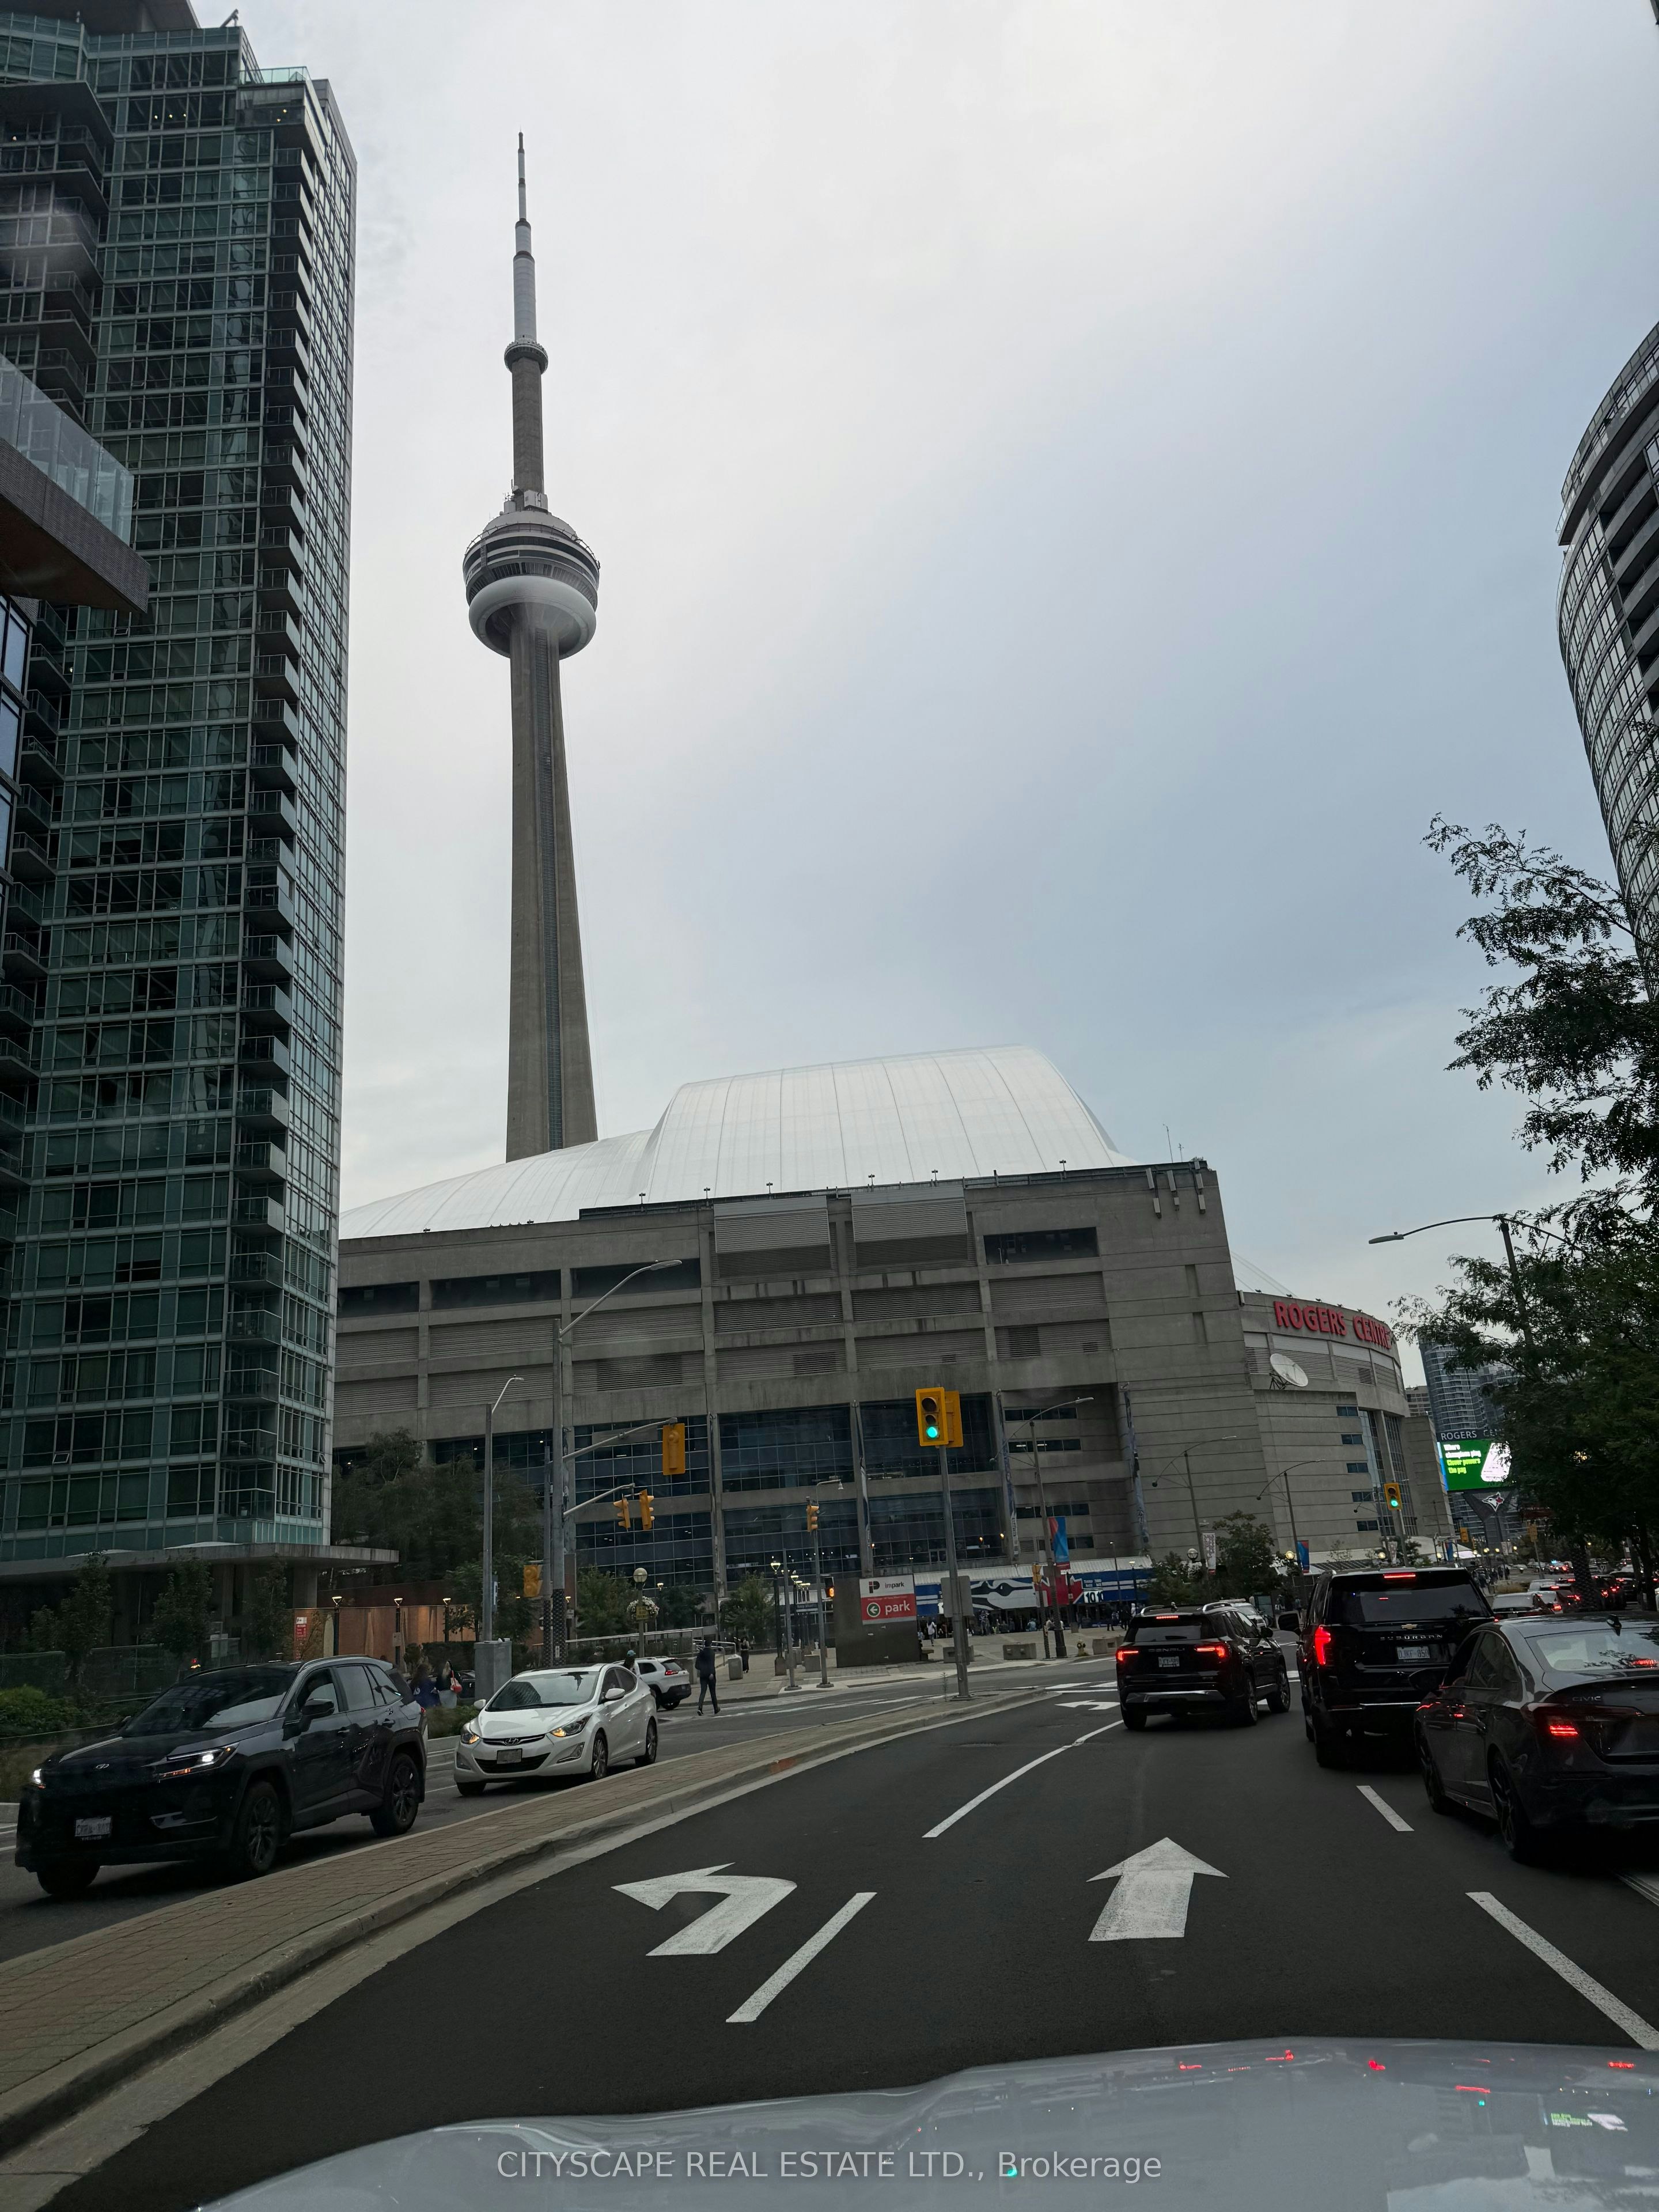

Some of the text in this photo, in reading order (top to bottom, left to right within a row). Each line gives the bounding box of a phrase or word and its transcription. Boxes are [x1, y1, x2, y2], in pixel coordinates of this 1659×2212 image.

[1274, 1301, 1392, 1350] ROGERS CENTRE
[1441, 1430, 1477, 1440] ROGERS
[885, 1600, 911, 1615] park
